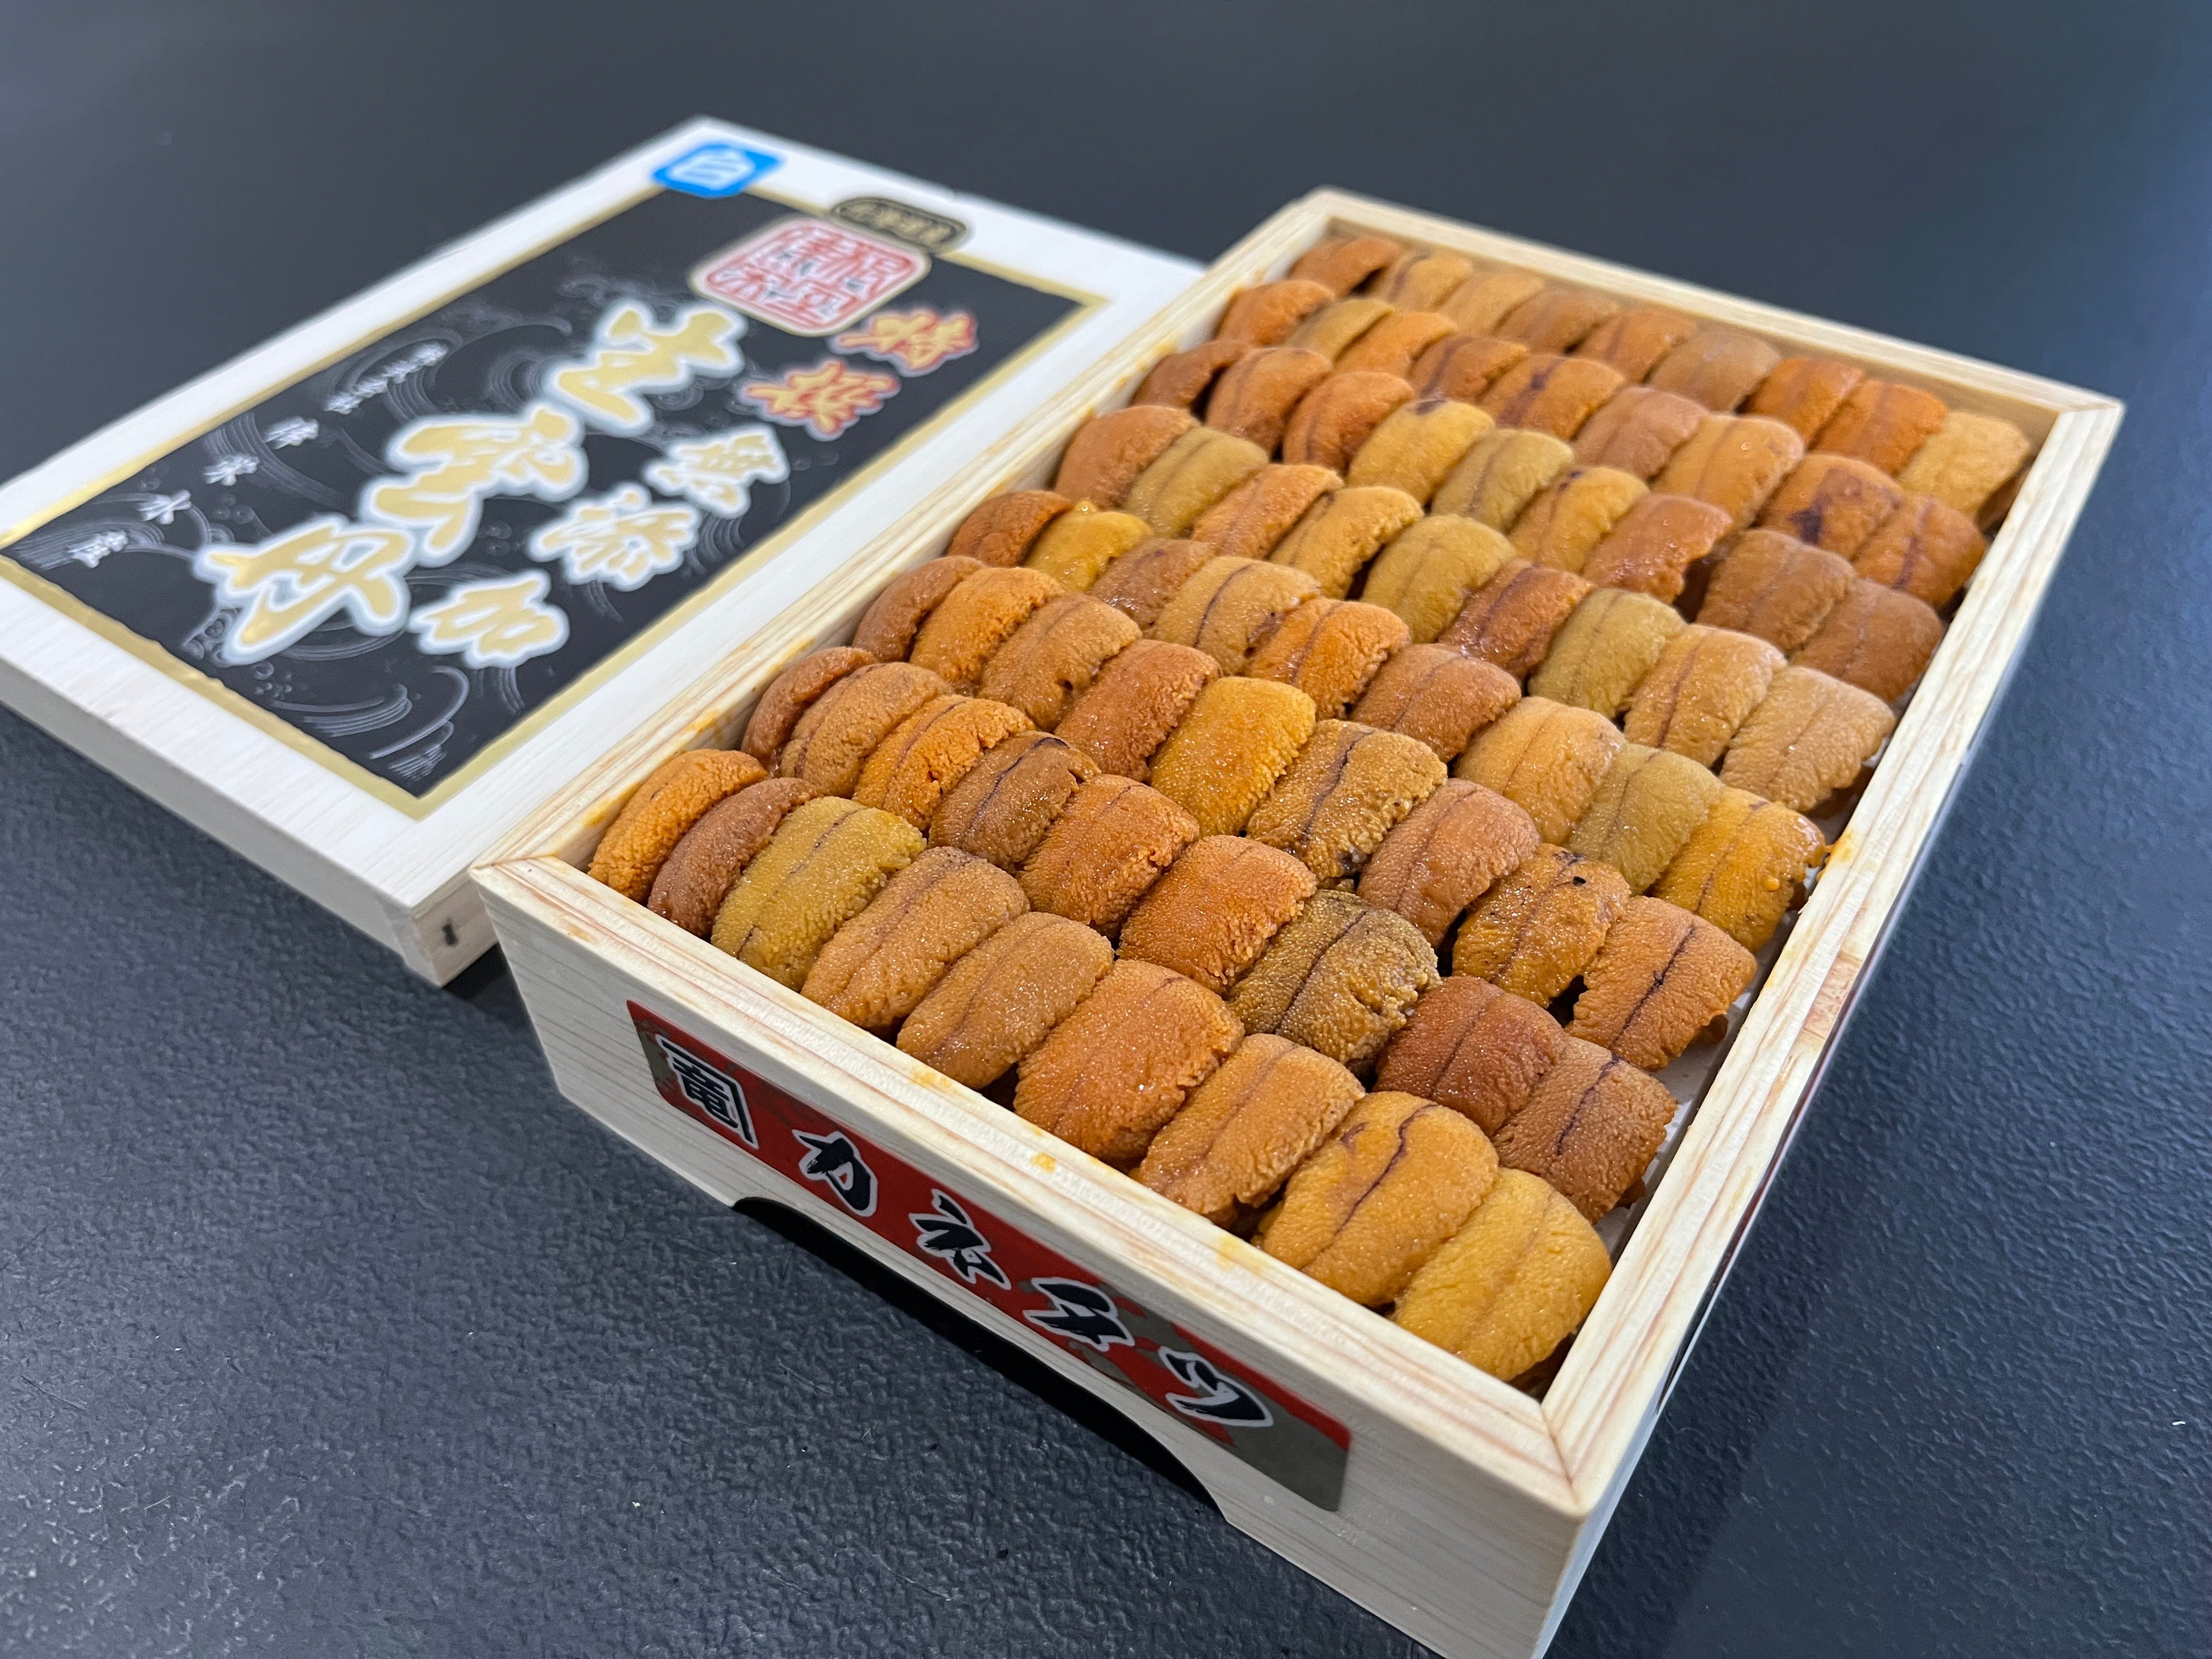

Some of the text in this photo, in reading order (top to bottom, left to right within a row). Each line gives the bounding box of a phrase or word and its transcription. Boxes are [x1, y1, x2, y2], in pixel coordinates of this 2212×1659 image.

[192, 297, 748, 667] 生雲丹
[408, 424, 791, 669] 無添加
[792, 1127, 1274, 1427] カネタツ
